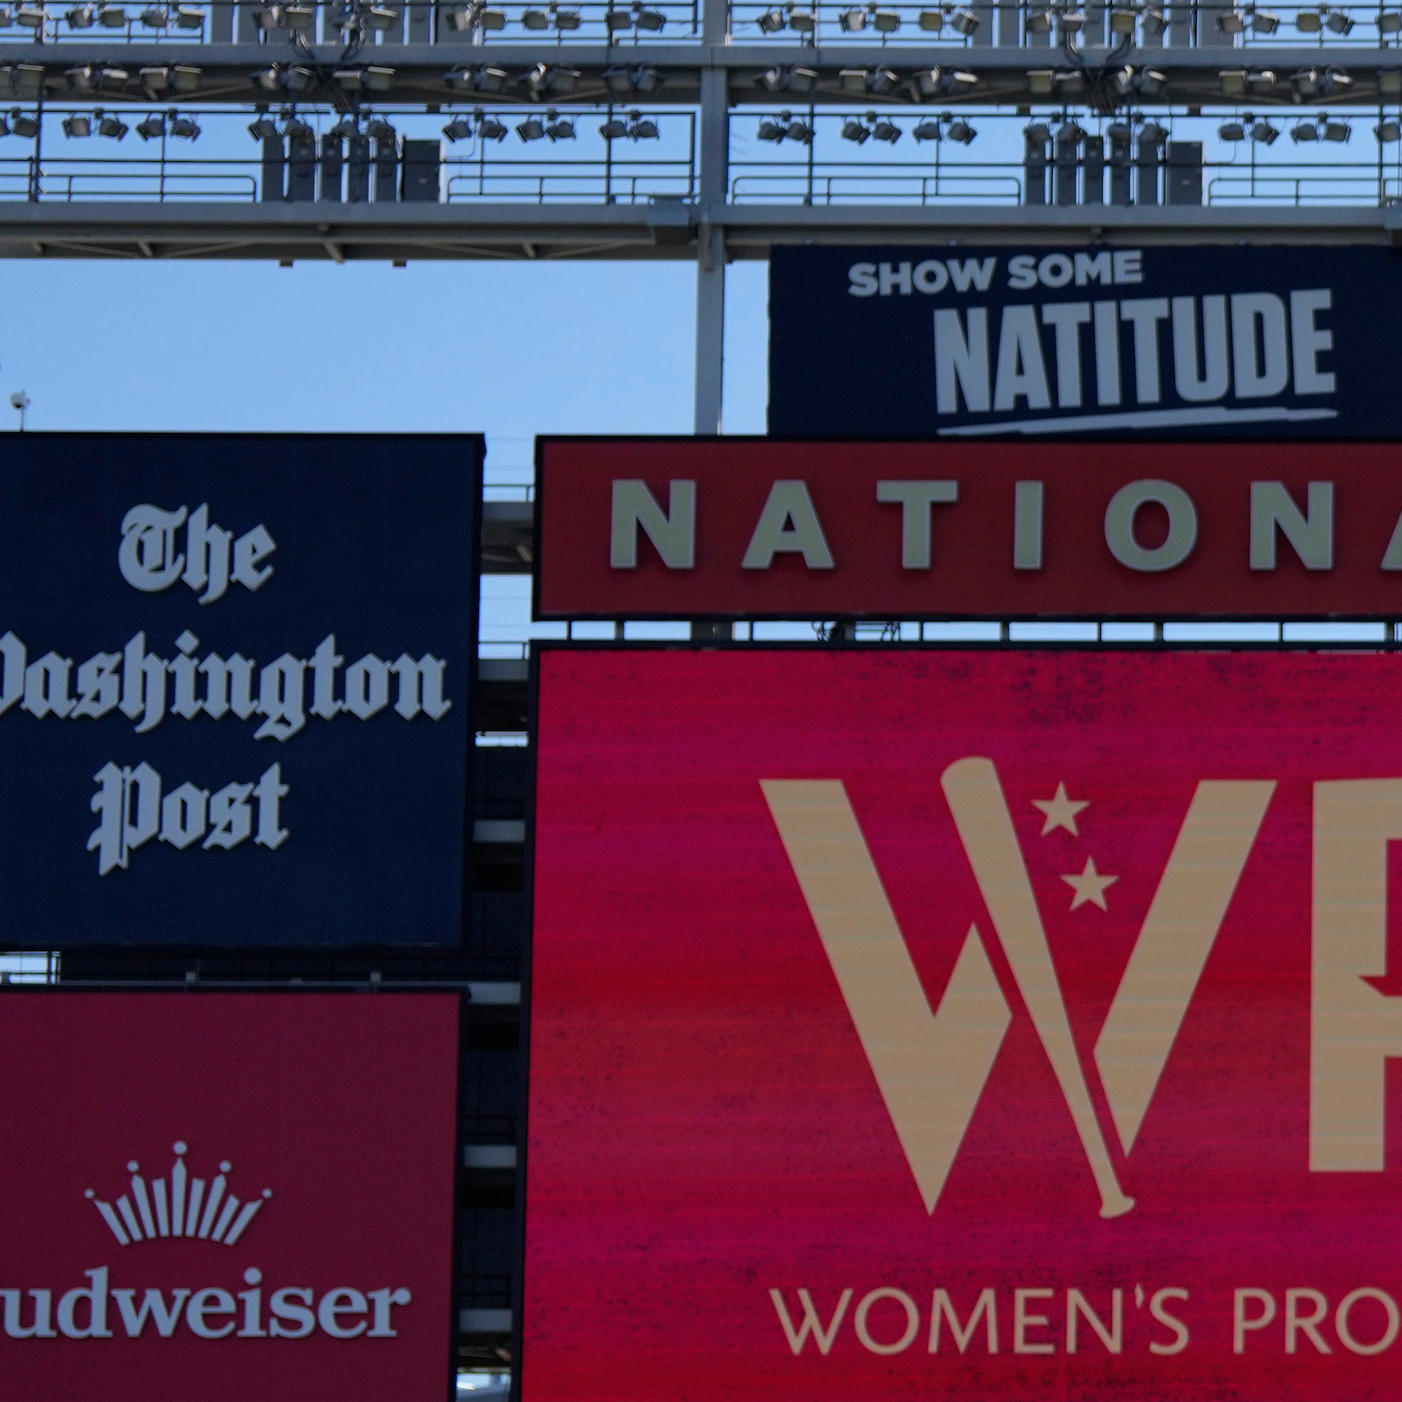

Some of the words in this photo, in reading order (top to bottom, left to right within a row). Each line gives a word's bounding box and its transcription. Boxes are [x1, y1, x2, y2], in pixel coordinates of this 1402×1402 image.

[847, 256, 996, 297] SHOW
[1007, 250, 1145, 290] SOME
[933, 288, 1338, 415] NATITUDE
[118, 502, 277, 604] The
[87, 760, 290, 876] Post
[768, 1283, 1190, 1356] WOMEN'S
[1232, 1287, 1400, 1356] PRO
